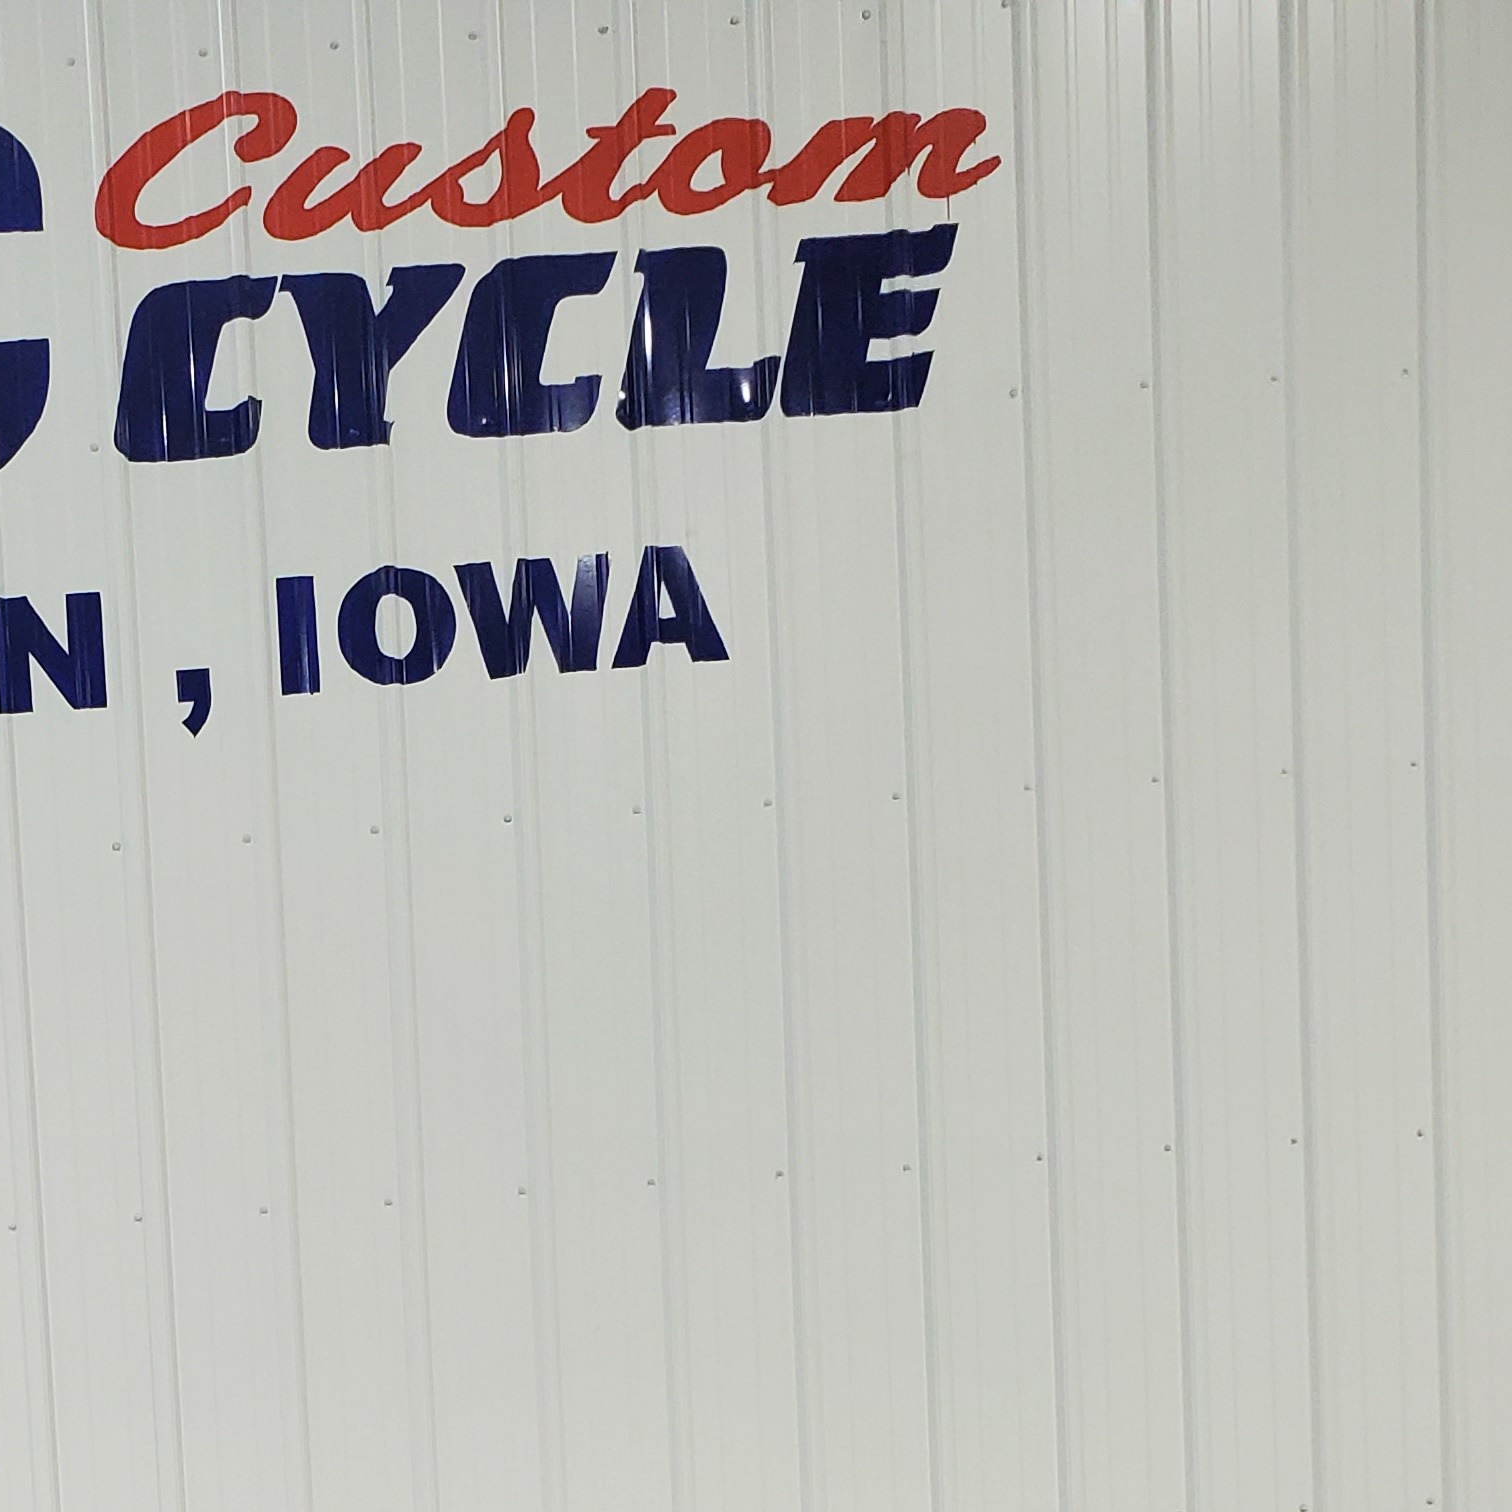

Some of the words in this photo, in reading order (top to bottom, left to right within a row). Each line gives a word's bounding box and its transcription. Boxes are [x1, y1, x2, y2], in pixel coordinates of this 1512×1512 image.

[94, 86, 1000, 252] Custom
[113, 222, 959, 463] CYCLE
[275, 545, 730, 696] IOWA
